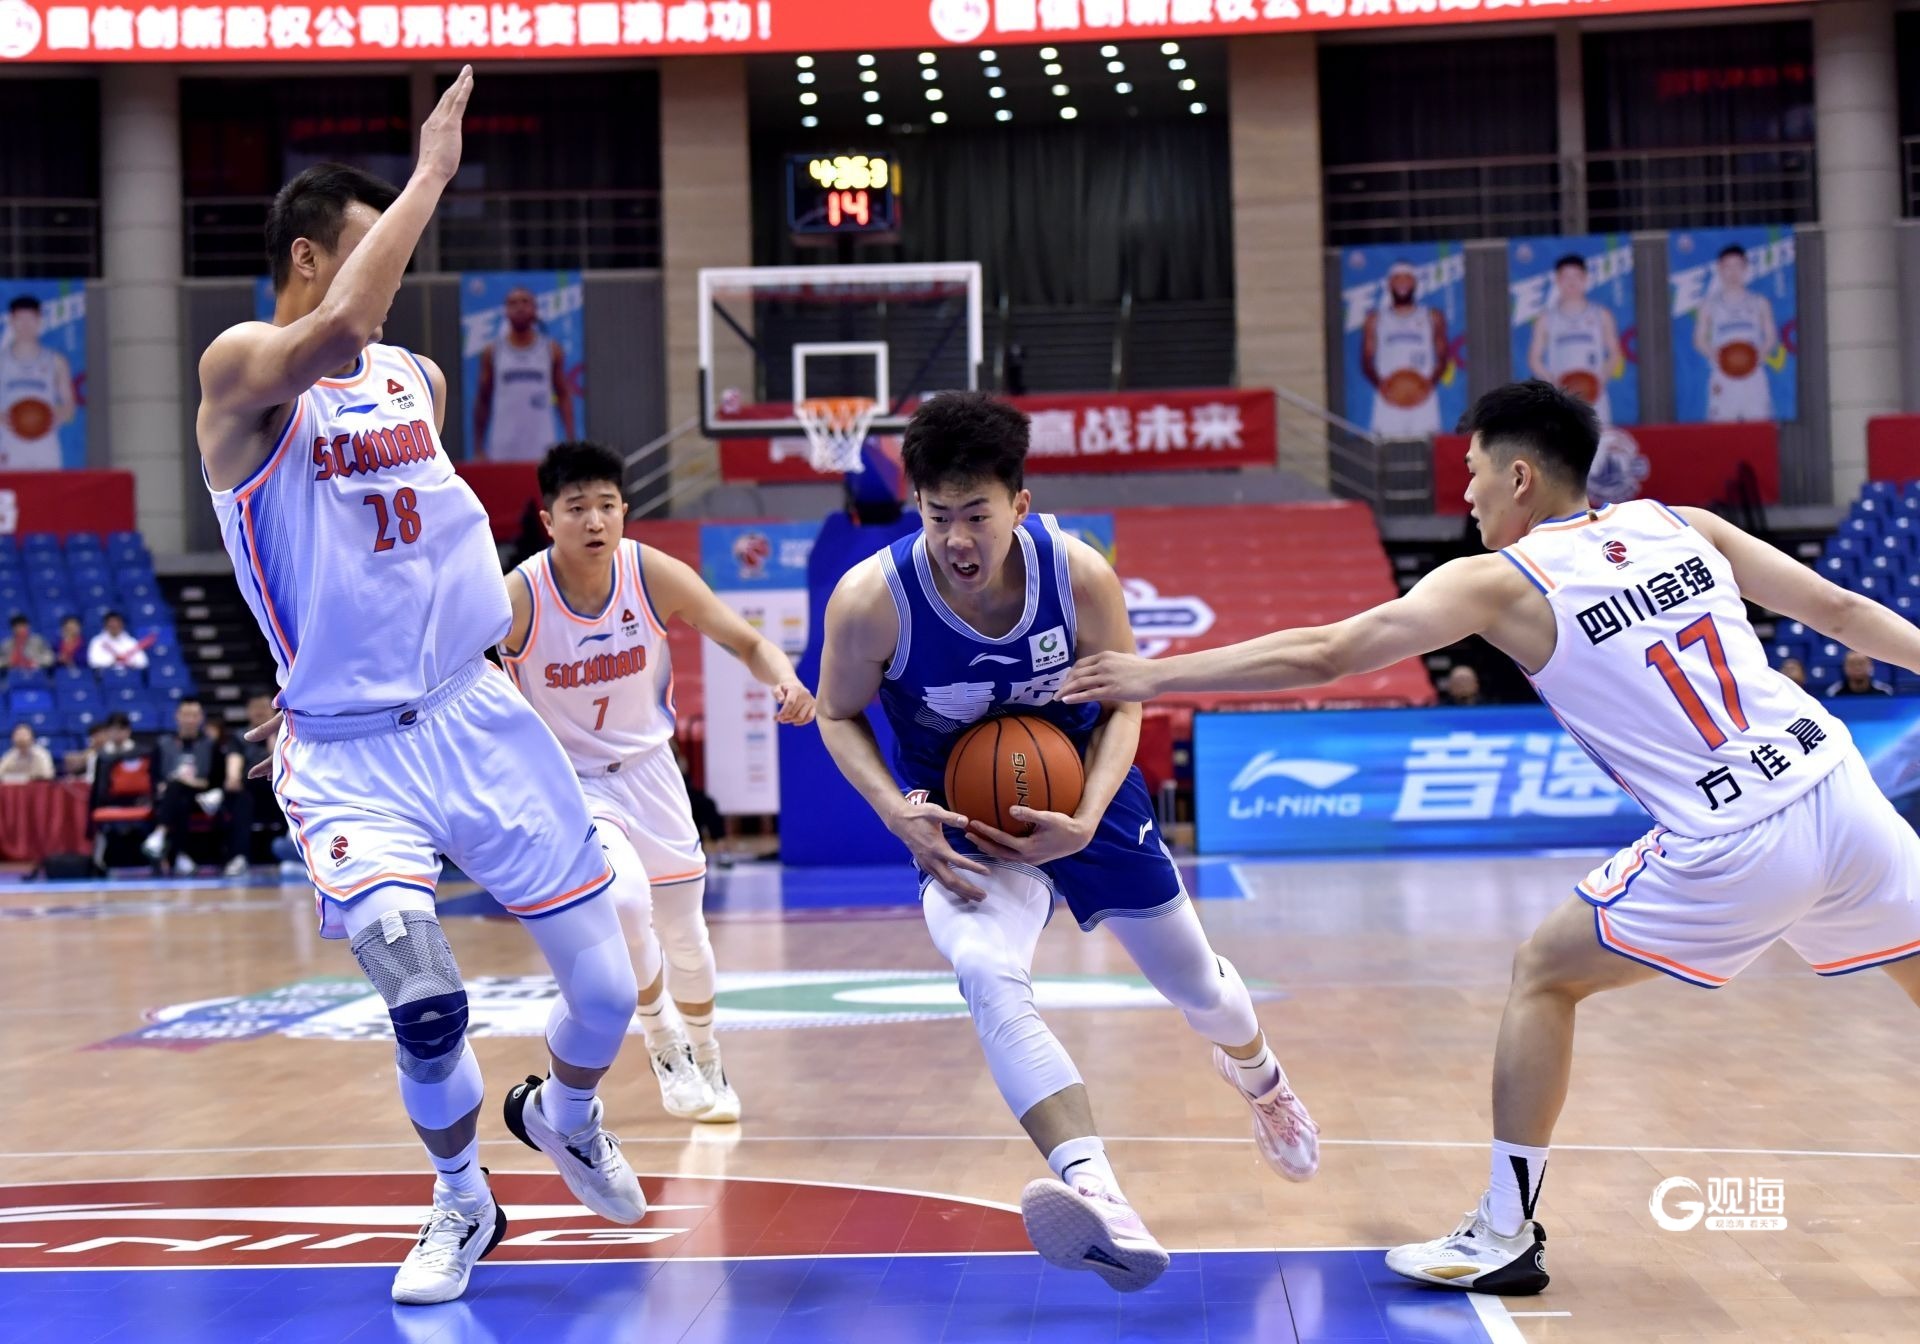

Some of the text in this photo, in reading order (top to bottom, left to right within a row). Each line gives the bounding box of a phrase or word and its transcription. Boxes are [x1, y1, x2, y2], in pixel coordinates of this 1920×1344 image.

[828, 191, 869, 226] 14
[313, 419, 436, 481] SCHUAN
[363, 487, 422, 553] 28
[1576, 556, 1715, 645] 四川金强
[1645, 612, 1750, 751] 17
[592, 696, 610, 731] 7
[1229, 794, 1363, 819] LI-NING
